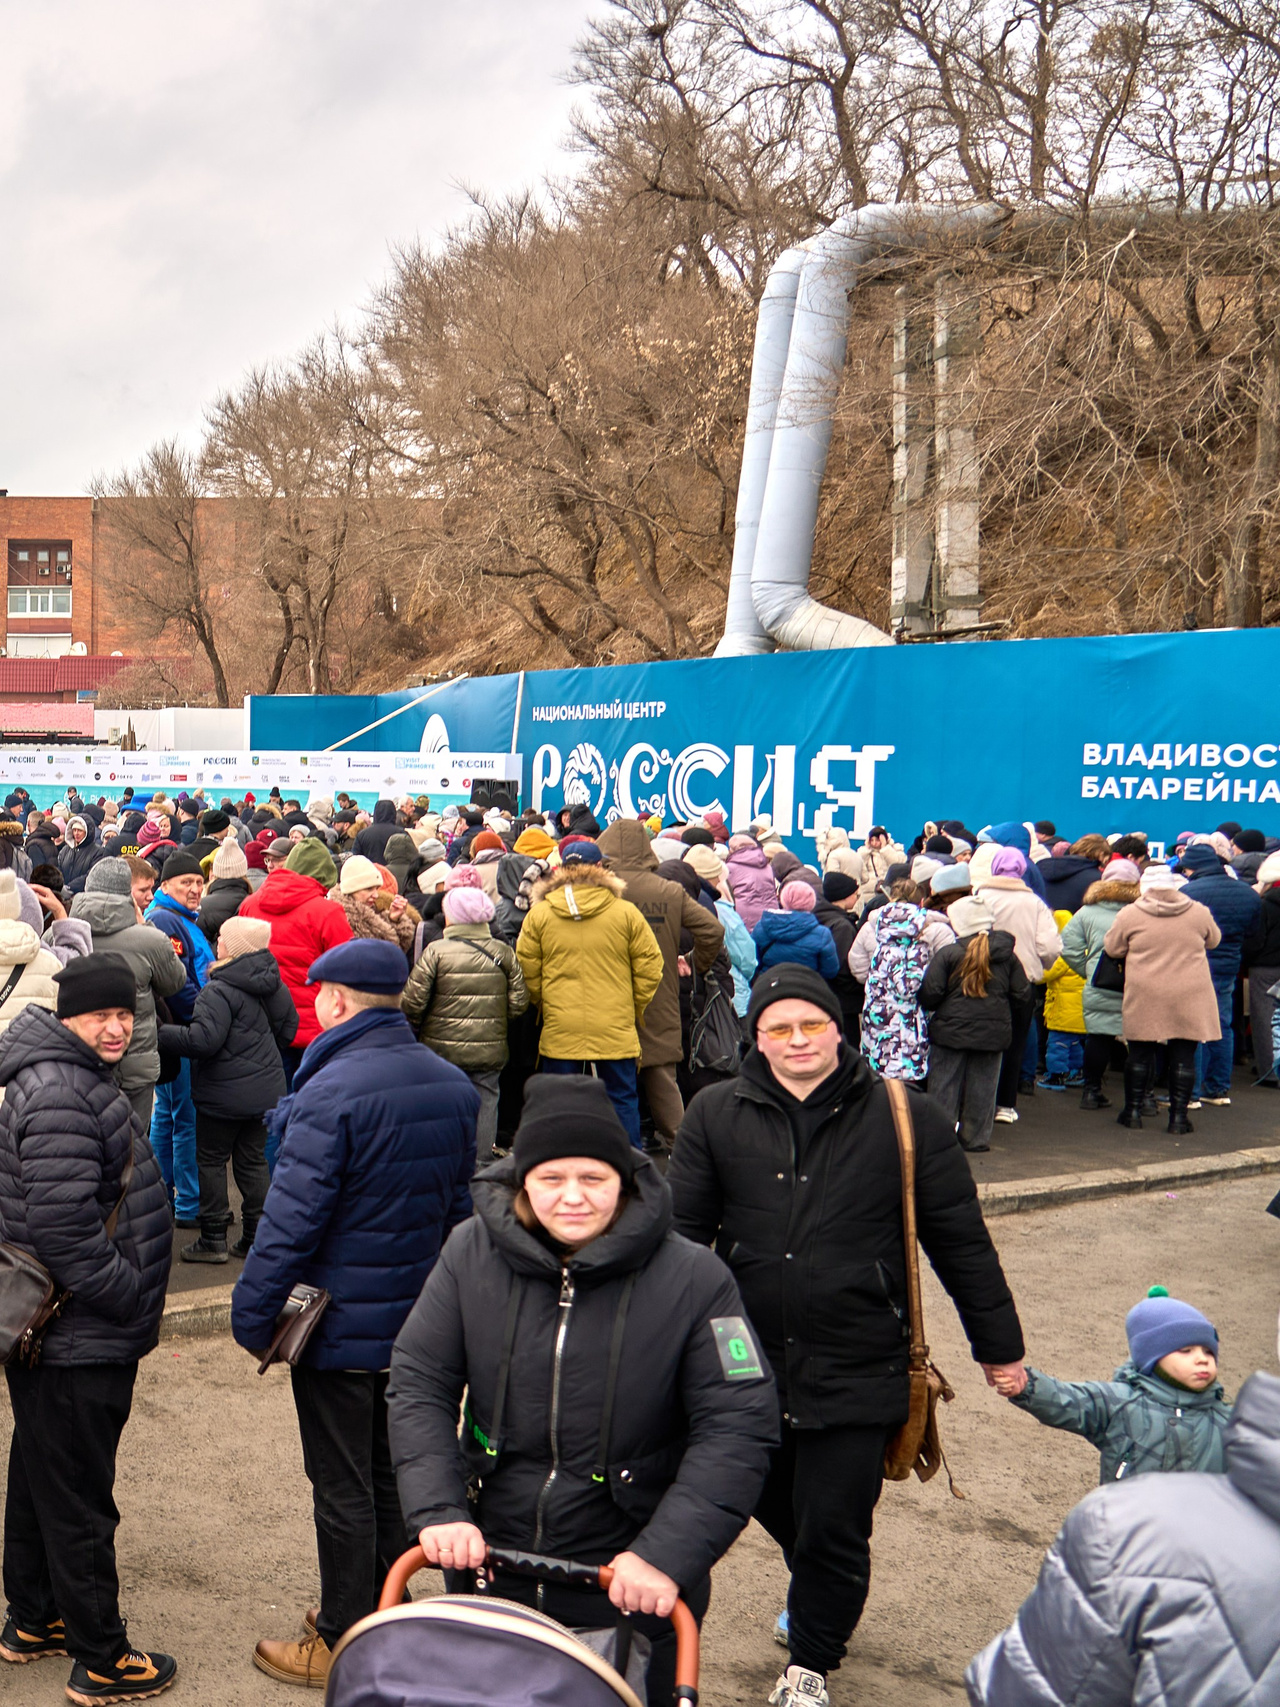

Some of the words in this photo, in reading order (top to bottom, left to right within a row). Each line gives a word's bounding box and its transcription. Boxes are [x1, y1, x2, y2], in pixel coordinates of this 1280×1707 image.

[532, 698, 623, 724] НАЦИОНАЛЬНЫЙ
[624, 701, 667, 722] ЦЕНТР
[203, 756, 237, 765] РОССИЯ
[451, 759, 495, 769] РОССИЯ
[1082, 742, 1280, 770] ВЛАДИВОС
[532, 742, 895, 840] РОССИЯ
[728, 1338, 749, 1361] G
